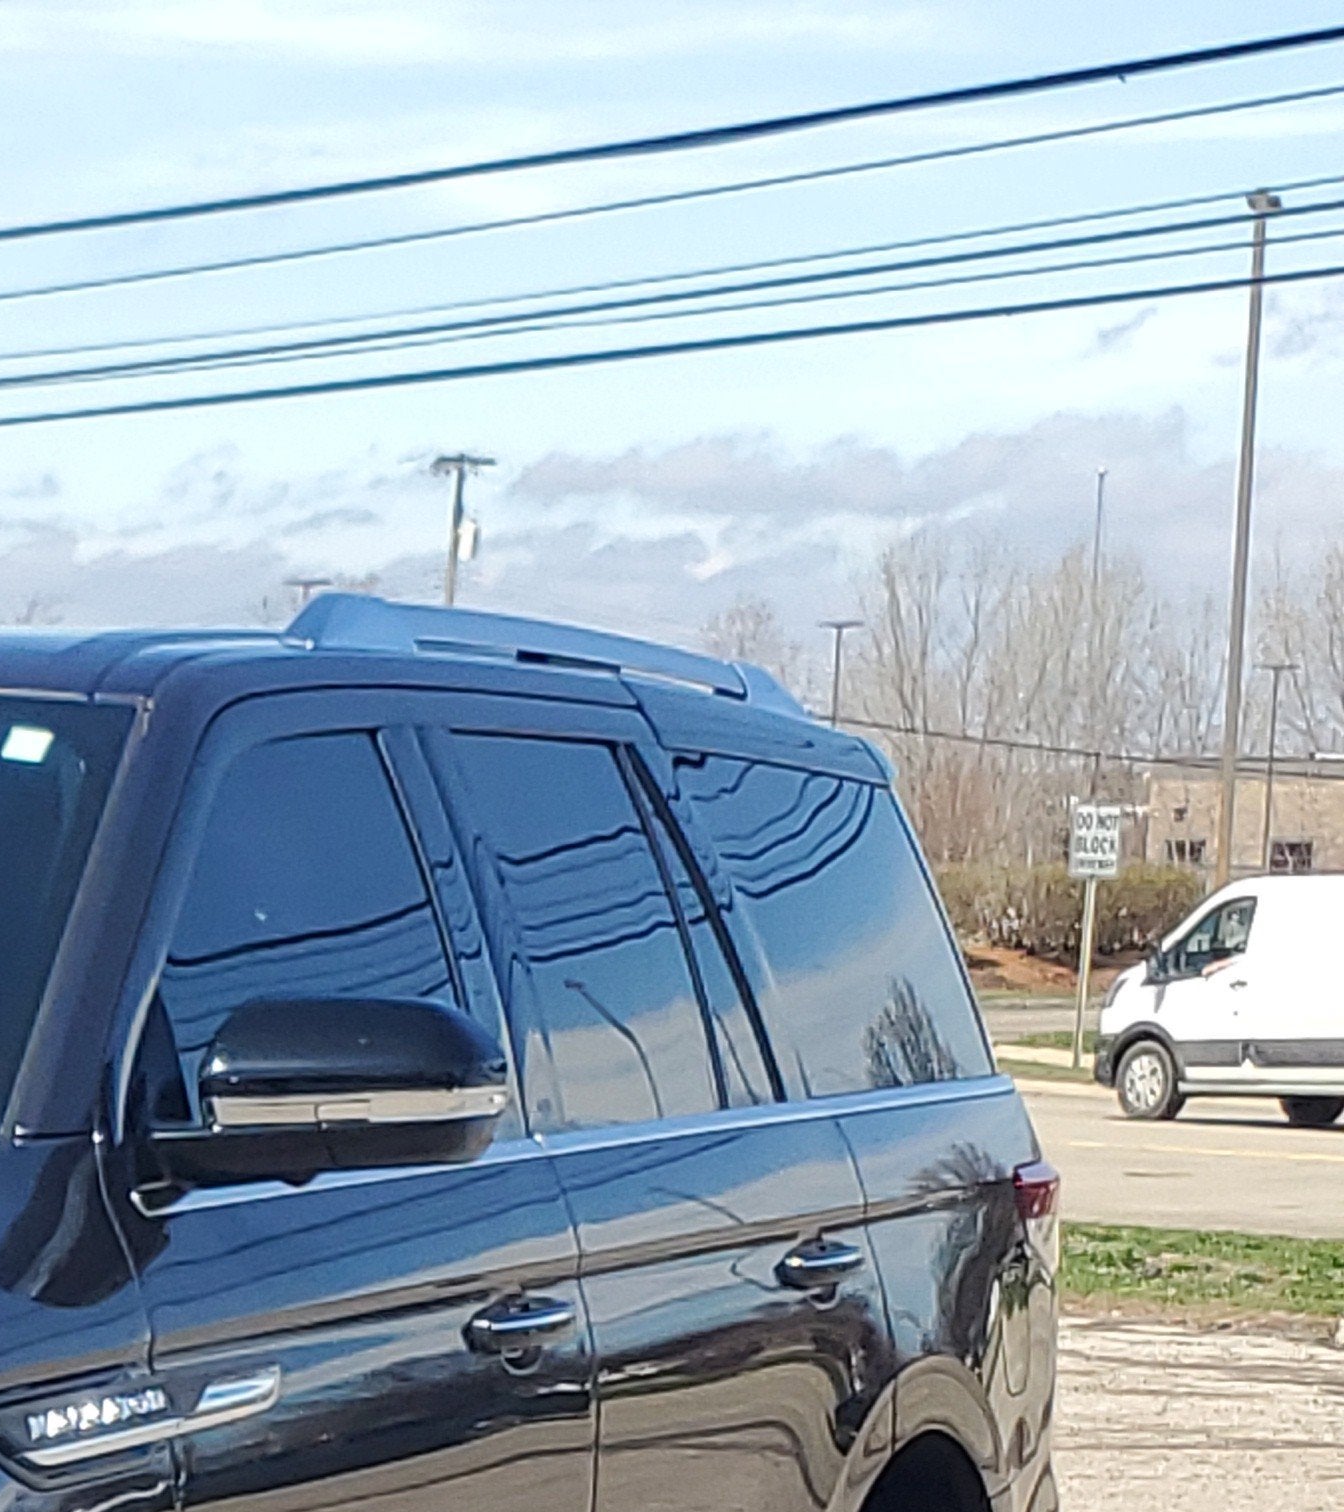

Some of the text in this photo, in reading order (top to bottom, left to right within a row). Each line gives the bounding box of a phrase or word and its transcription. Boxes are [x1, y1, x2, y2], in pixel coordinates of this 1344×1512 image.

[1076, 811, 1119, 831] DO NOT
[1075, 835, 1116, 855] BLOCK
